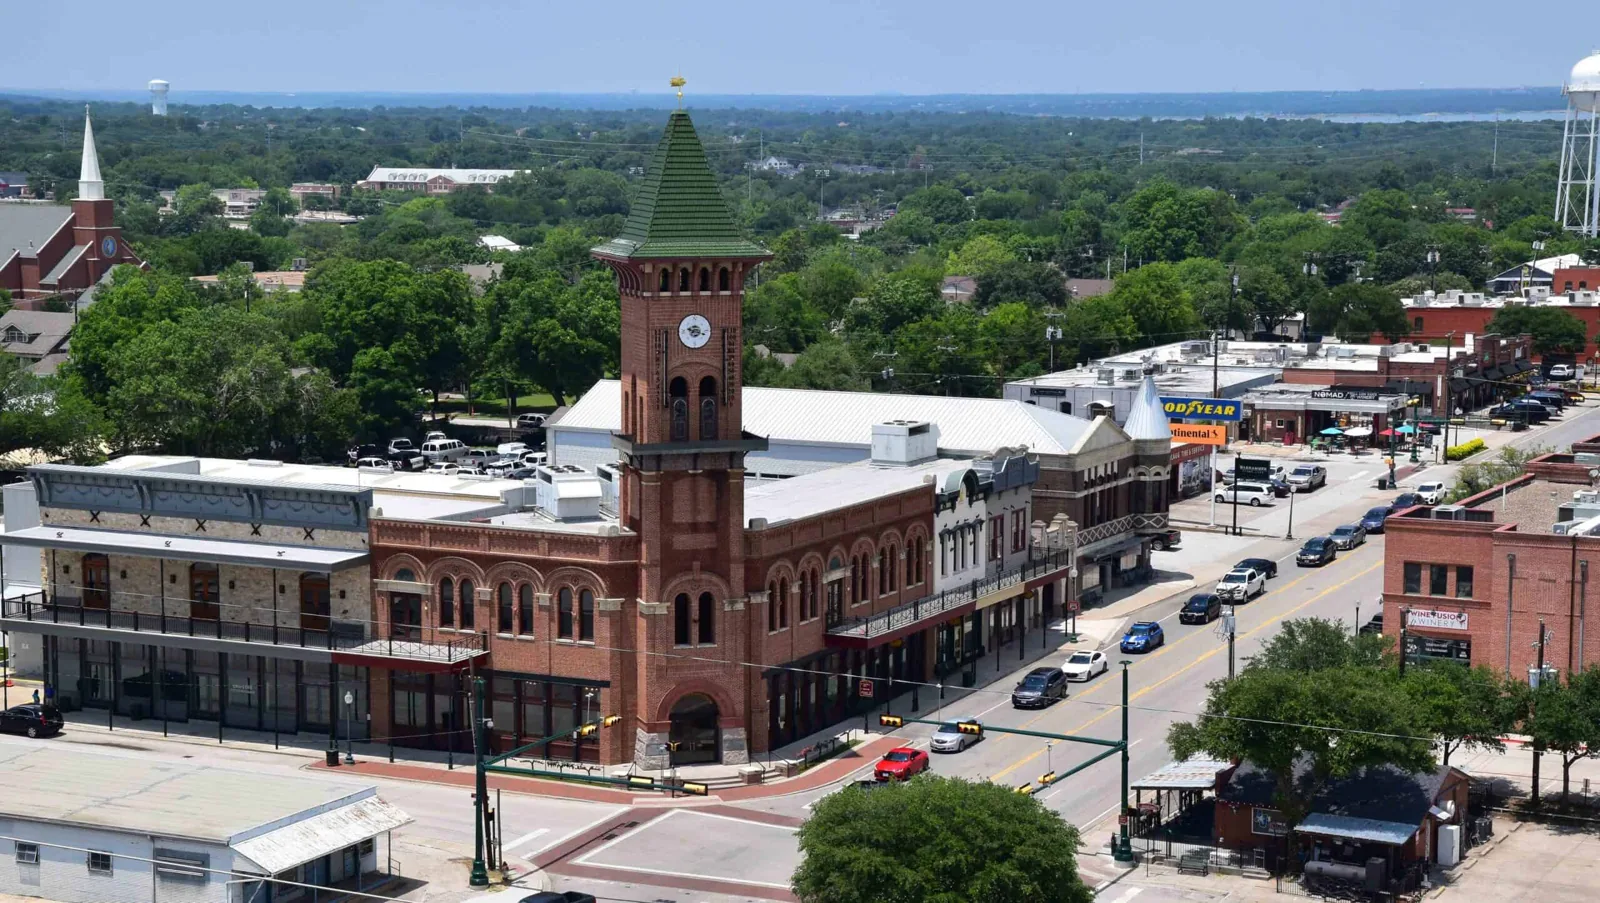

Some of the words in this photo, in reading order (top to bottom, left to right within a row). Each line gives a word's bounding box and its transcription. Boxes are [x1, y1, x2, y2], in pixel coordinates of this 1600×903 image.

[1314, 391, 1344, 399] NOMAD
[1162, 401, 1236, 416] ODYEAR
[1433, 612, 1462, 621] USIO
[1418, 619, 1455, 627] WINERY
